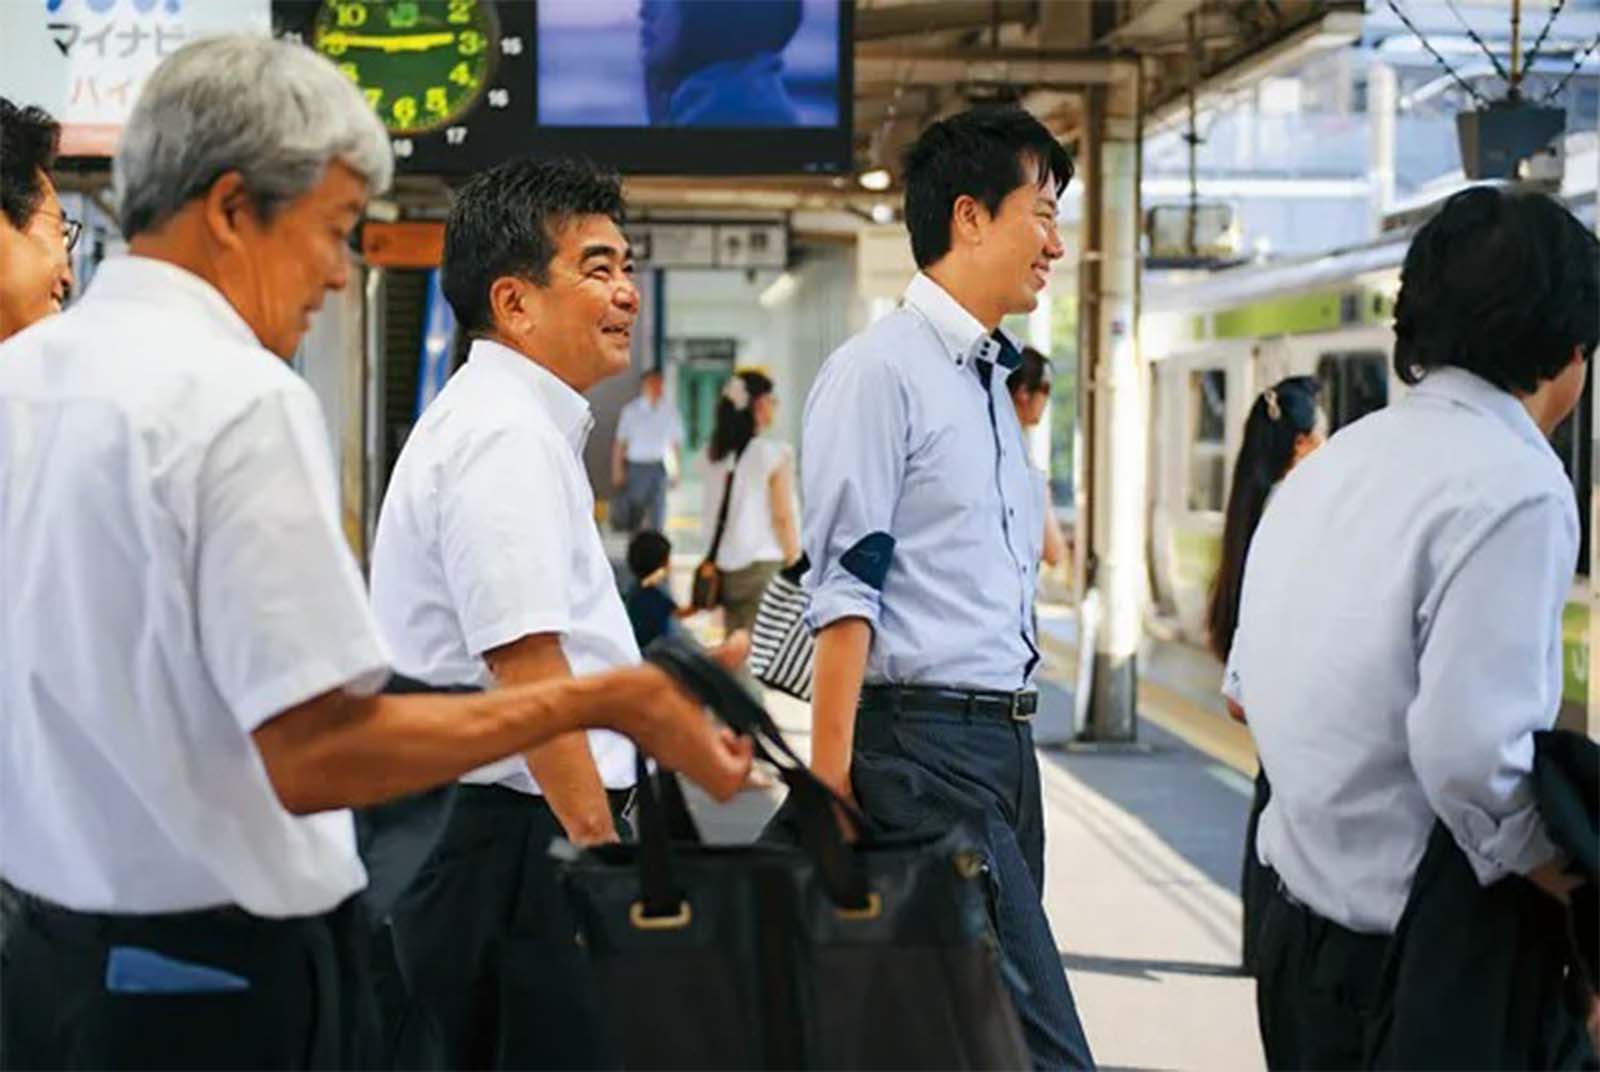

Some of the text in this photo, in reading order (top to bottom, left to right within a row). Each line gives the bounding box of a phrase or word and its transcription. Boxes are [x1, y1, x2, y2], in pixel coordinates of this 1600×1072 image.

[338, 2, 367, 27] 10
[449, 0, 470, 23] 2
[459, 31, 478, 55] 3
[449, 62, 470, 86] 4
[393, 97, 416, 121] 6
[426, 87, 447, 113] 5
[446, 127, 467, 145] 17
